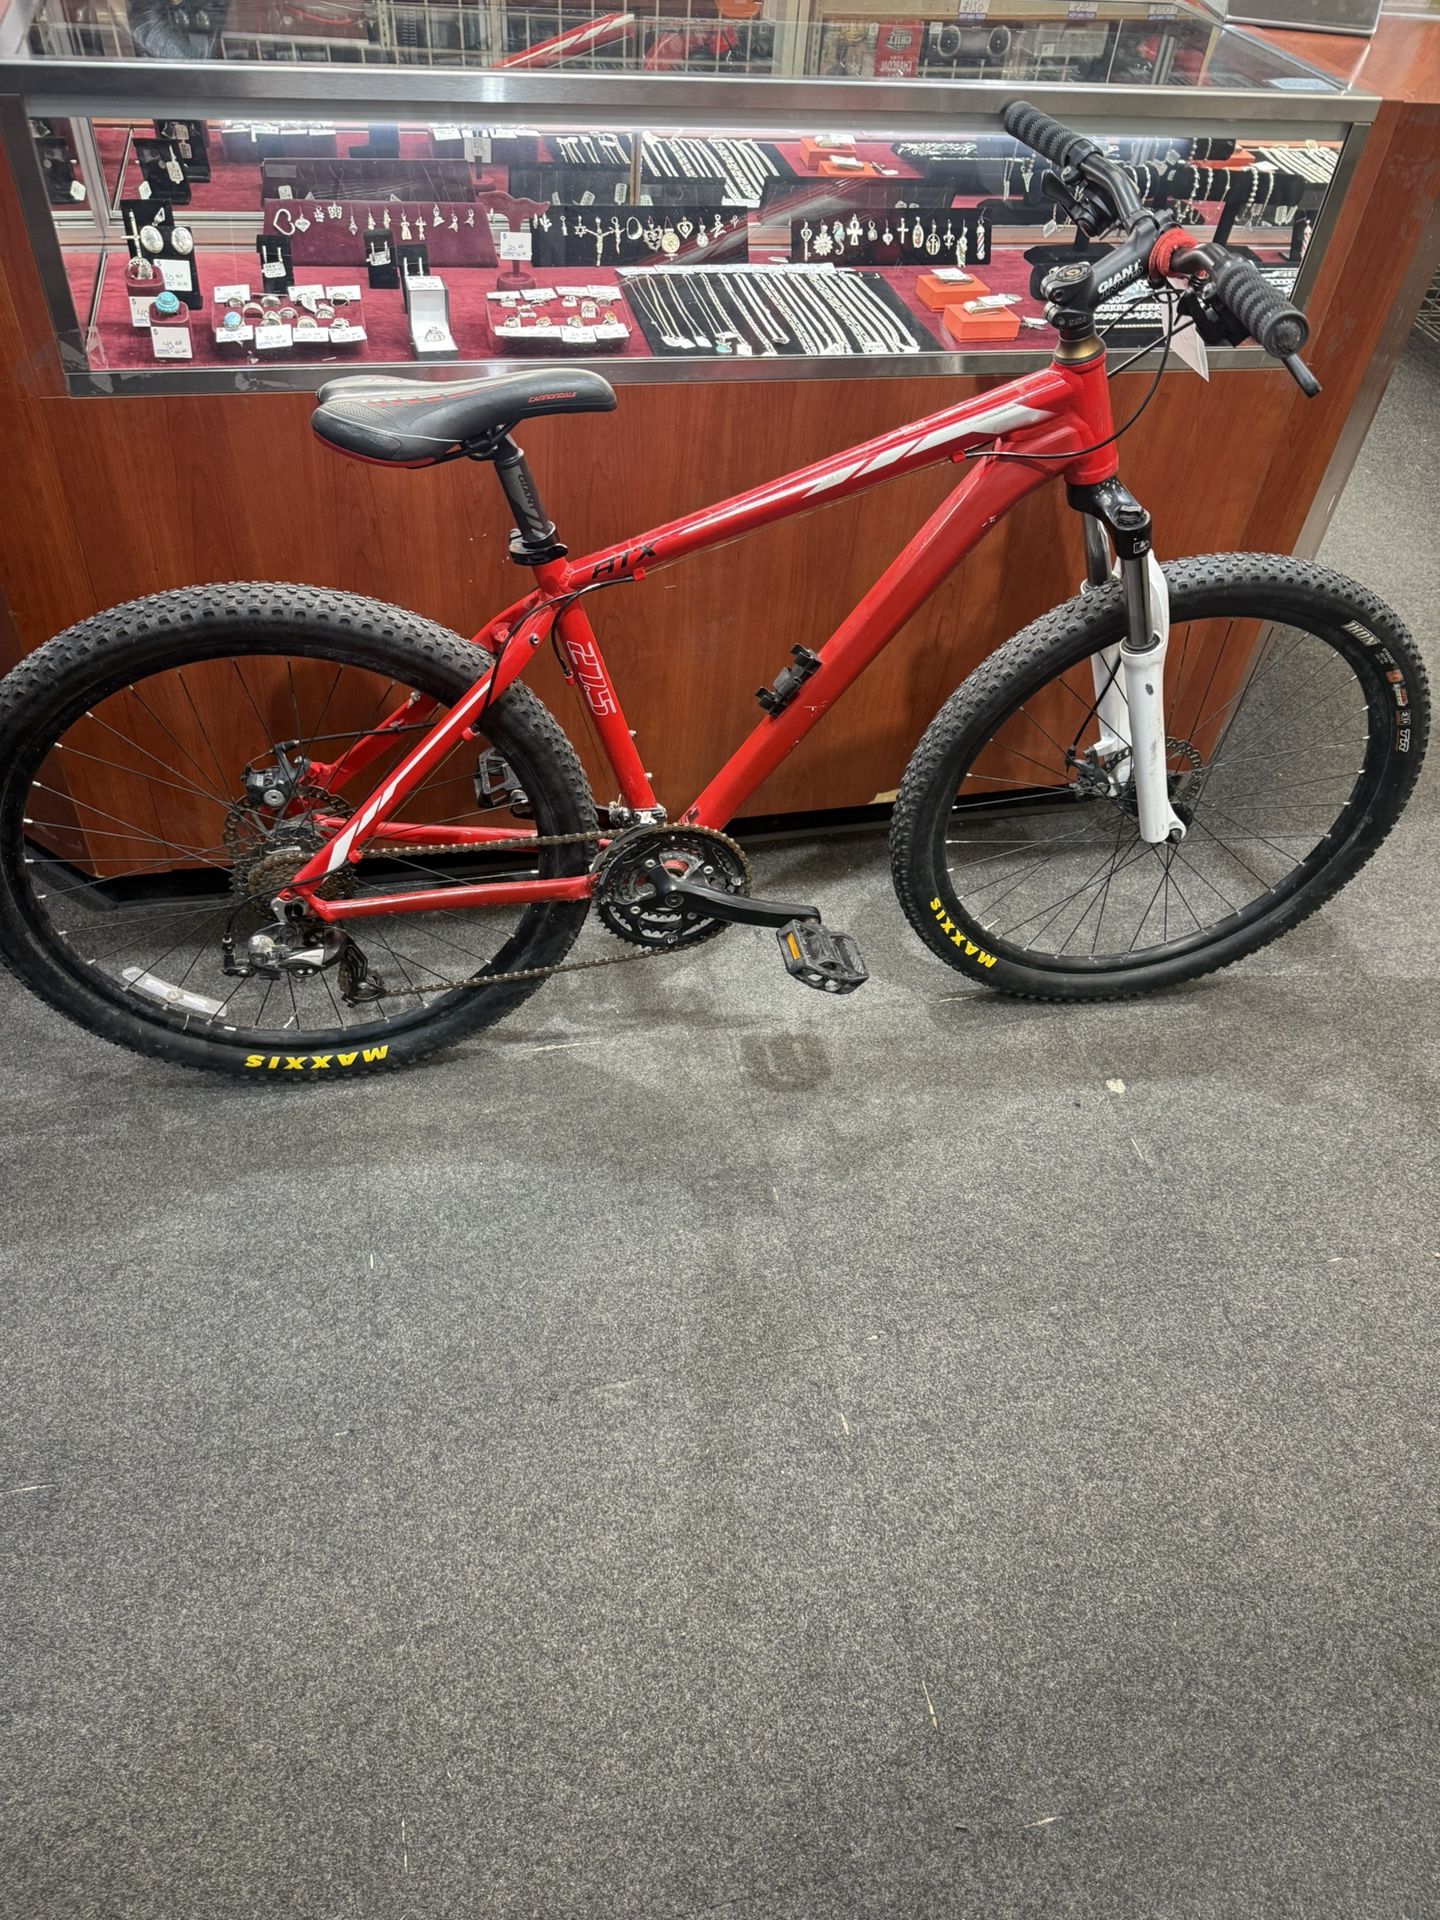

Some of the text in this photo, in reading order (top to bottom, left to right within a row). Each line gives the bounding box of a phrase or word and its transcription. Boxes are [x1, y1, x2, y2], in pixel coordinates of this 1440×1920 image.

[1097, 259, 1141, 294] GIANT
[528, 391, 578, 404] CANNONDALE
[516, 473, 535, 511] GIANT
[591, 540, 658, 580] ATX
[565, 639, 617, 718] 27.5
[930, 896, 998, 969] MAXXIS
[244, 1044, 389, 1071] MAXXIS
